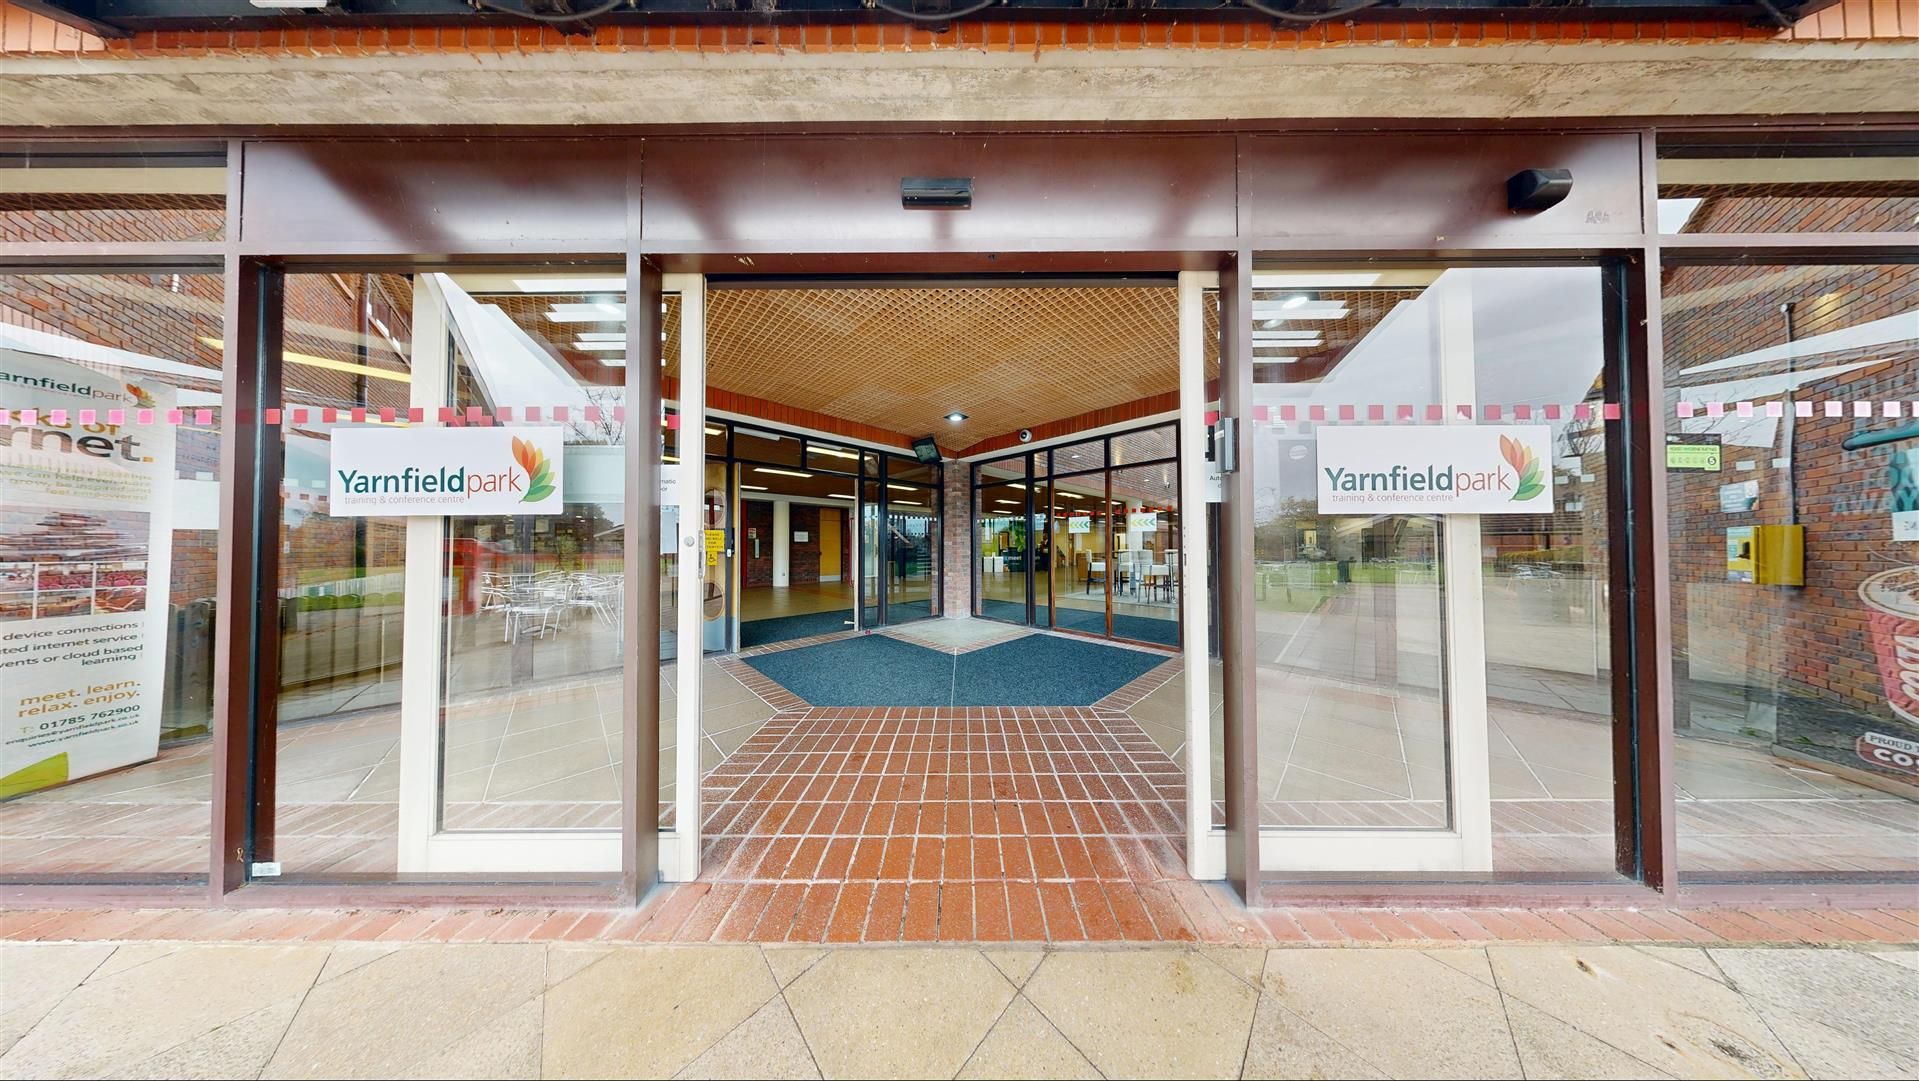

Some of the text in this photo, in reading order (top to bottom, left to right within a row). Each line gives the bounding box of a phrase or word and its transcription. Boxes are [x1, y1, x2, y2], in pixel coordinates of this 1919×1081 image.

[338, 466, 522, 498] Yarnfieldpark
[1324, 464, 1511, 497] Yarnfieldpark
[345, 496, 464, 505] training & conference centre
[1332, 494, 1453, 503] training & conference centre
[2, 621, 139, 641] device connections
[33, 638, 89, 651] internet
[93, 633, 138, 644] service
[43, 655, 60, 664] or
[62, 648, 100, 660] cloud
[104, 644, 143, 656] based
[81, 653, 137, 667] learning
[20, 680, 141, 706] meet. learn.
[18, 689, 141, 718] relax. enjoy.
[39, 714, 86, 731] 01785
[90, 704, 141, 720] 762900
[1870, 734, 1912, 750] PROUD
